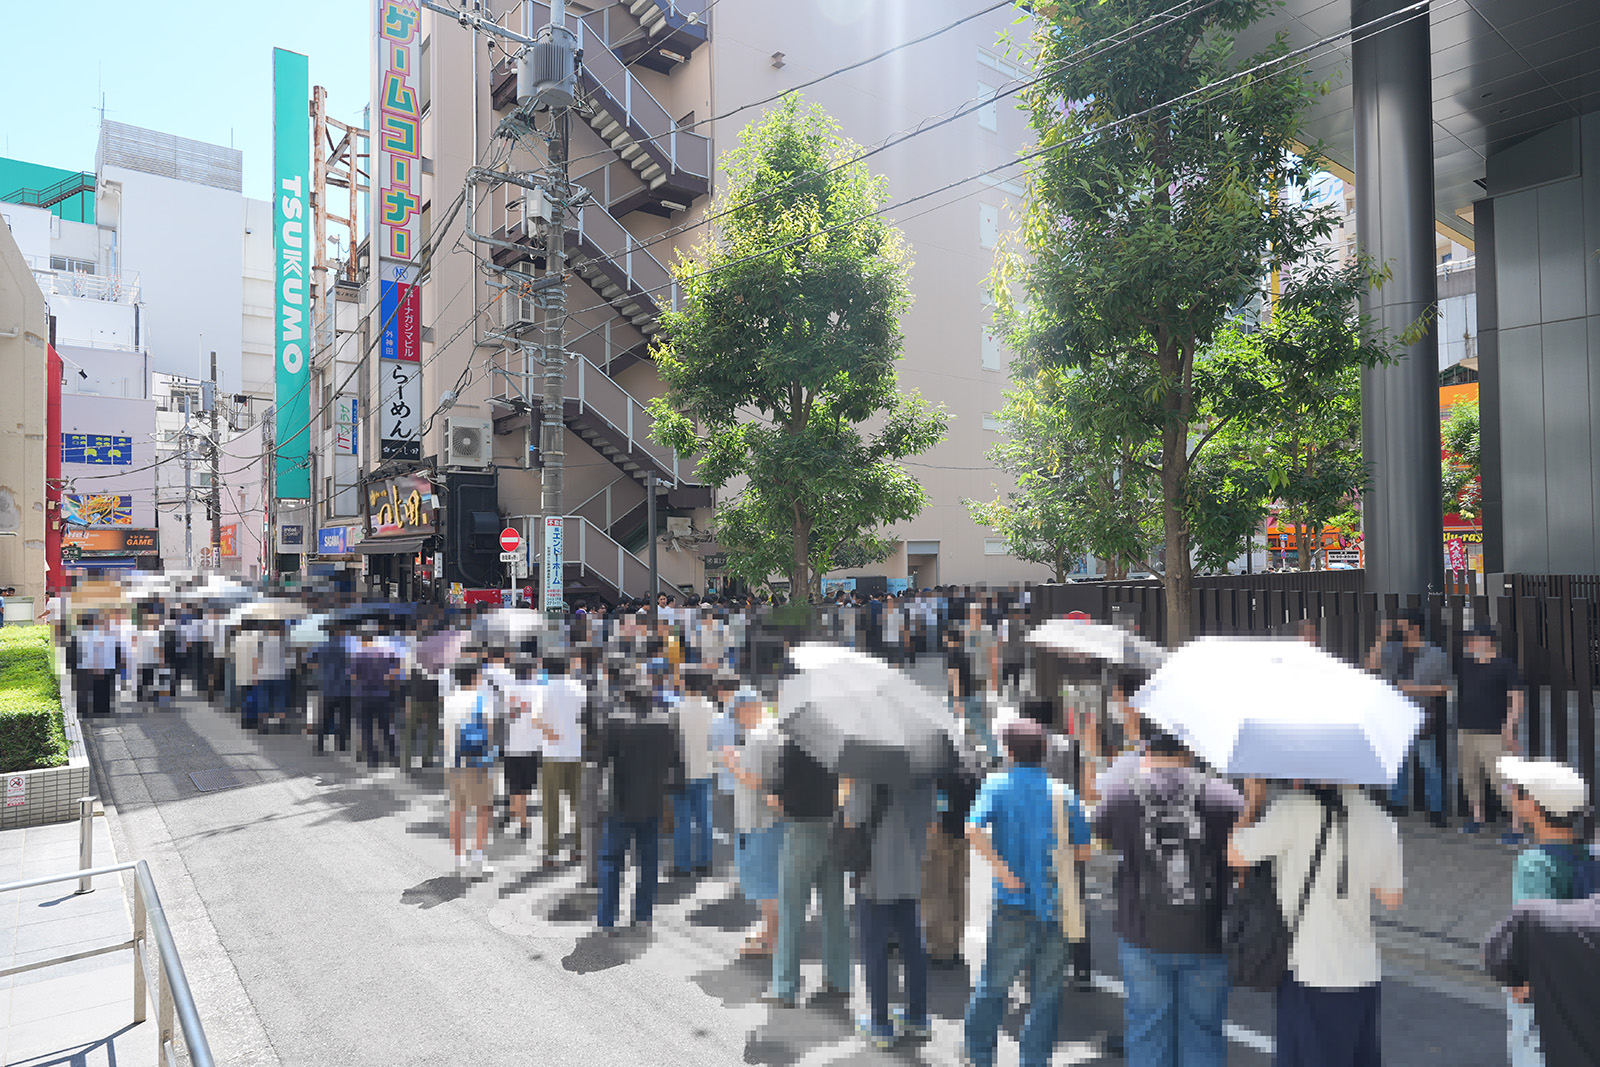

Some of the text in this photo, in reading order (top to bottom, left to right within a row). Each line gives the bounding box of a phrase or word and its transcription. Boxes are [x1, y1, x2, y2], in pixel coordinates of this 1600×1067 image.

[382, 1, 420, 259] ゲームコーナー
[282, 175, 303, 374] TSUKUMO
[389, 364, 412, 438] らーめん
[126, 538, 154, 546] GAME
